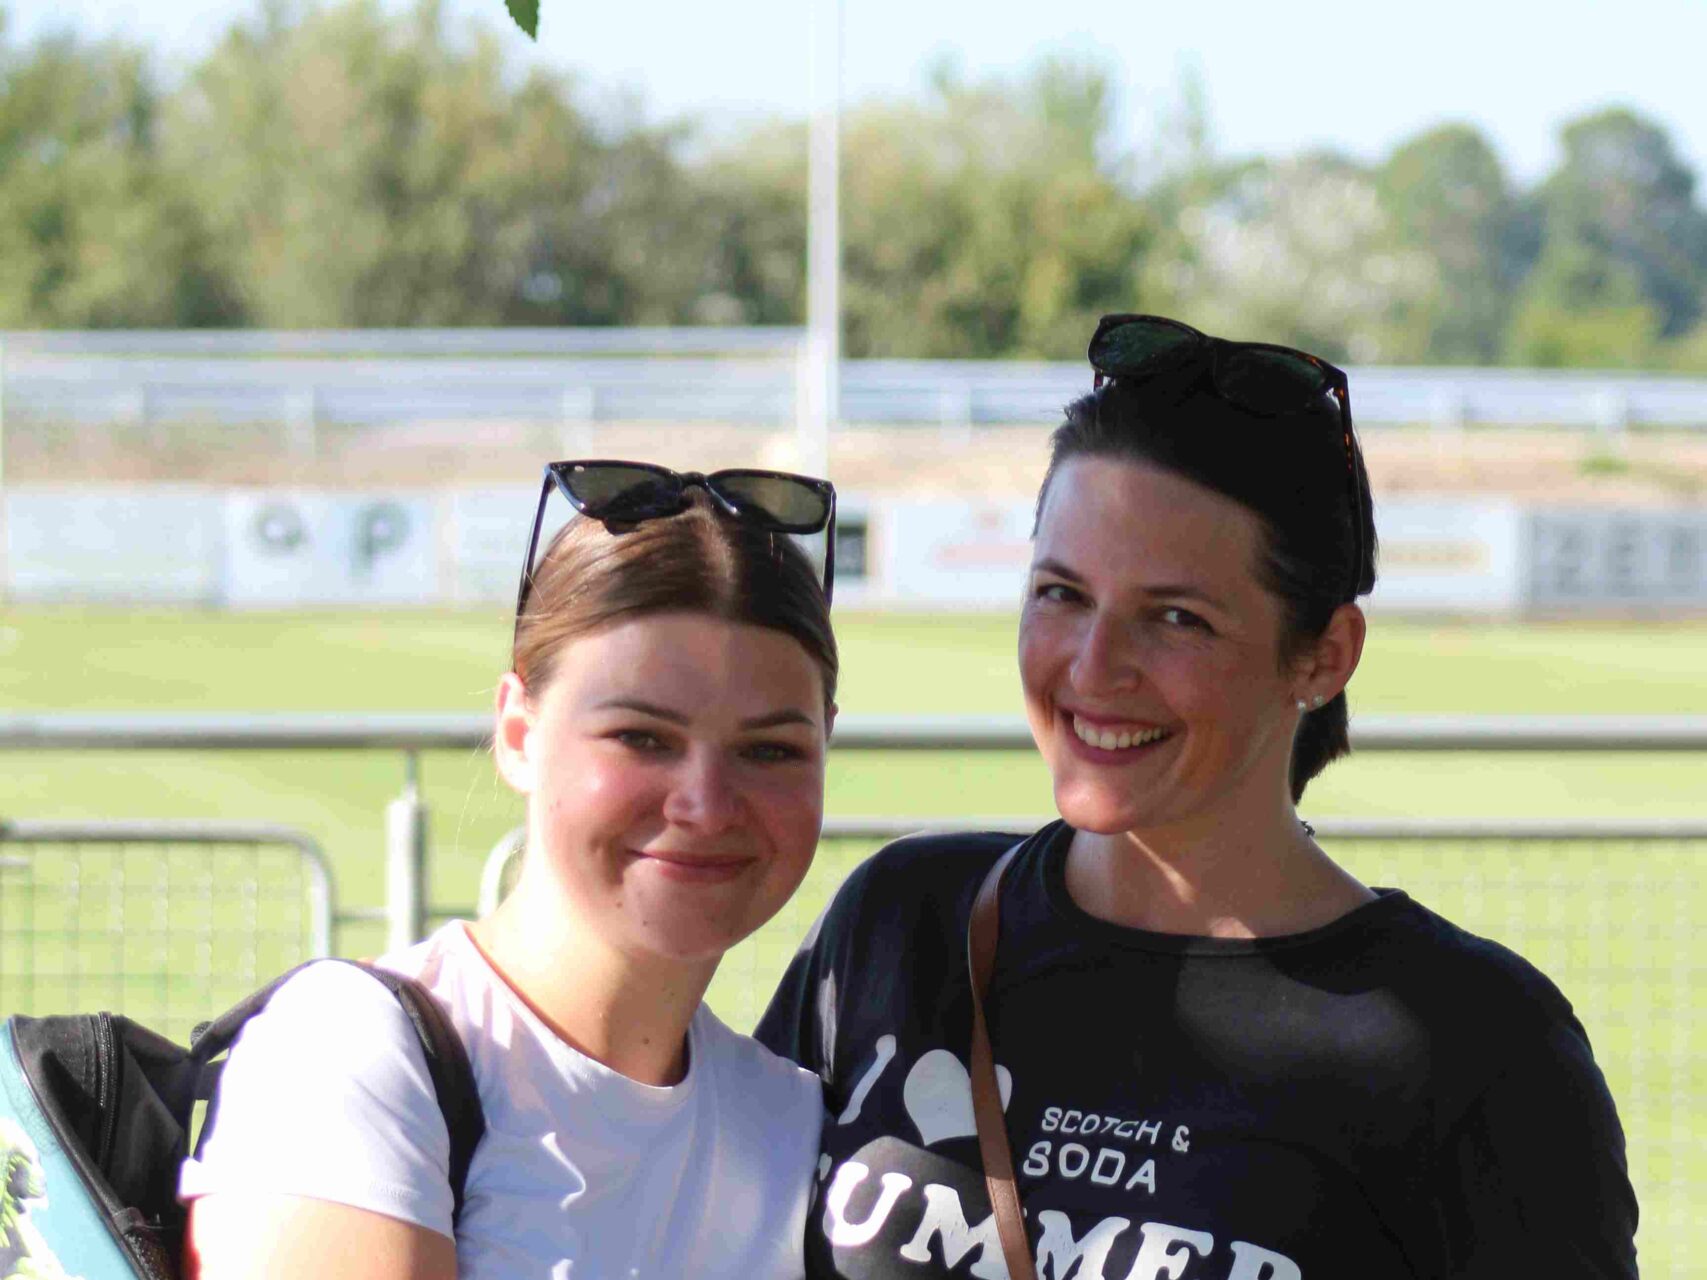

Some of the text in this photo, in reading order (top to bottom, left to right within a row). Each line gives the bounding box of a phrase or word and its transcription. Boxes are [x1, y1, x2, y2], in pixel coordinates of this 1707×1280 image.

[1041, 1106, 1190, 1152] SCOTCH &
[1022, 1140, 1156, 1194] SODA
